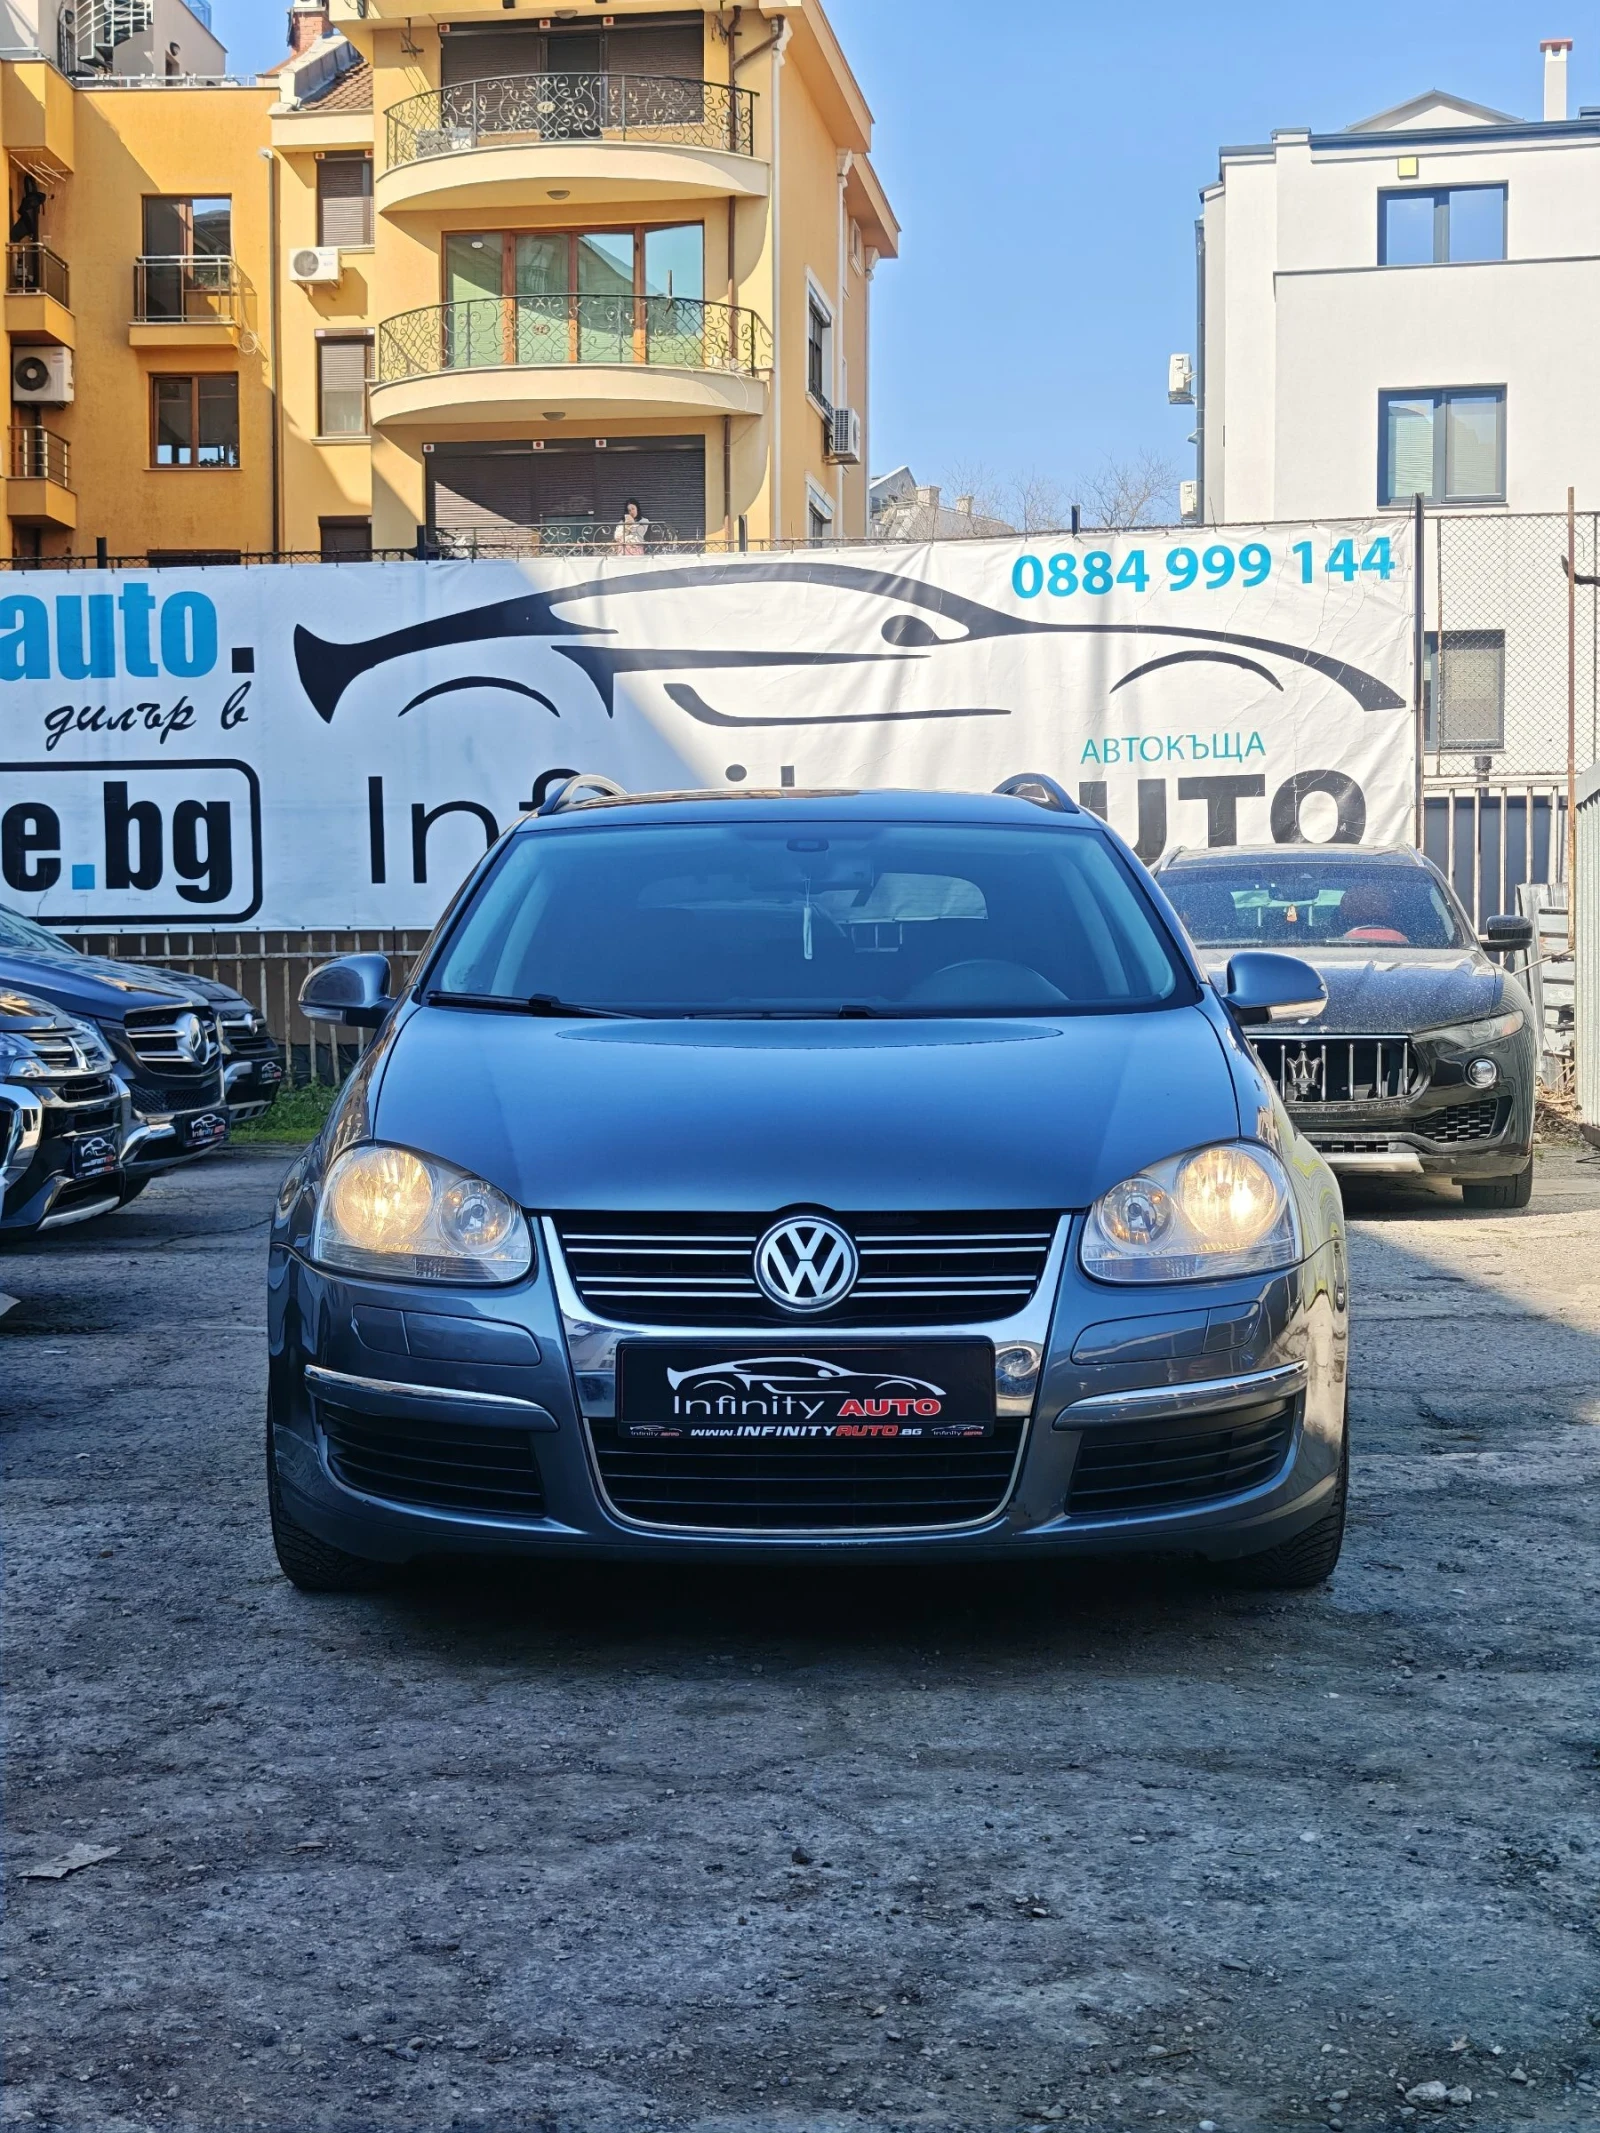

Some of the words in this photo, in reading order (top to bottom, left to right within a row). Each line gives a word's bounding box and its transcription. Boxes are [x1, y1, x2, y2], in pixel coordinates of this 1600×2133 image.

[1011, 550, 1150, 599] 0884
[1165, 542, 1272, 592] 999
[1292, 536, 1396, 584] 144
[44, 695, 197, 752] дилър
[1080, 731, 1267, 765] АВТОКЪЩА
[1078, 769, 1367, 868] UTO
[674, 1395, 824, 1419] Infinity
[837, 1398, 941, 1416] AUTO
